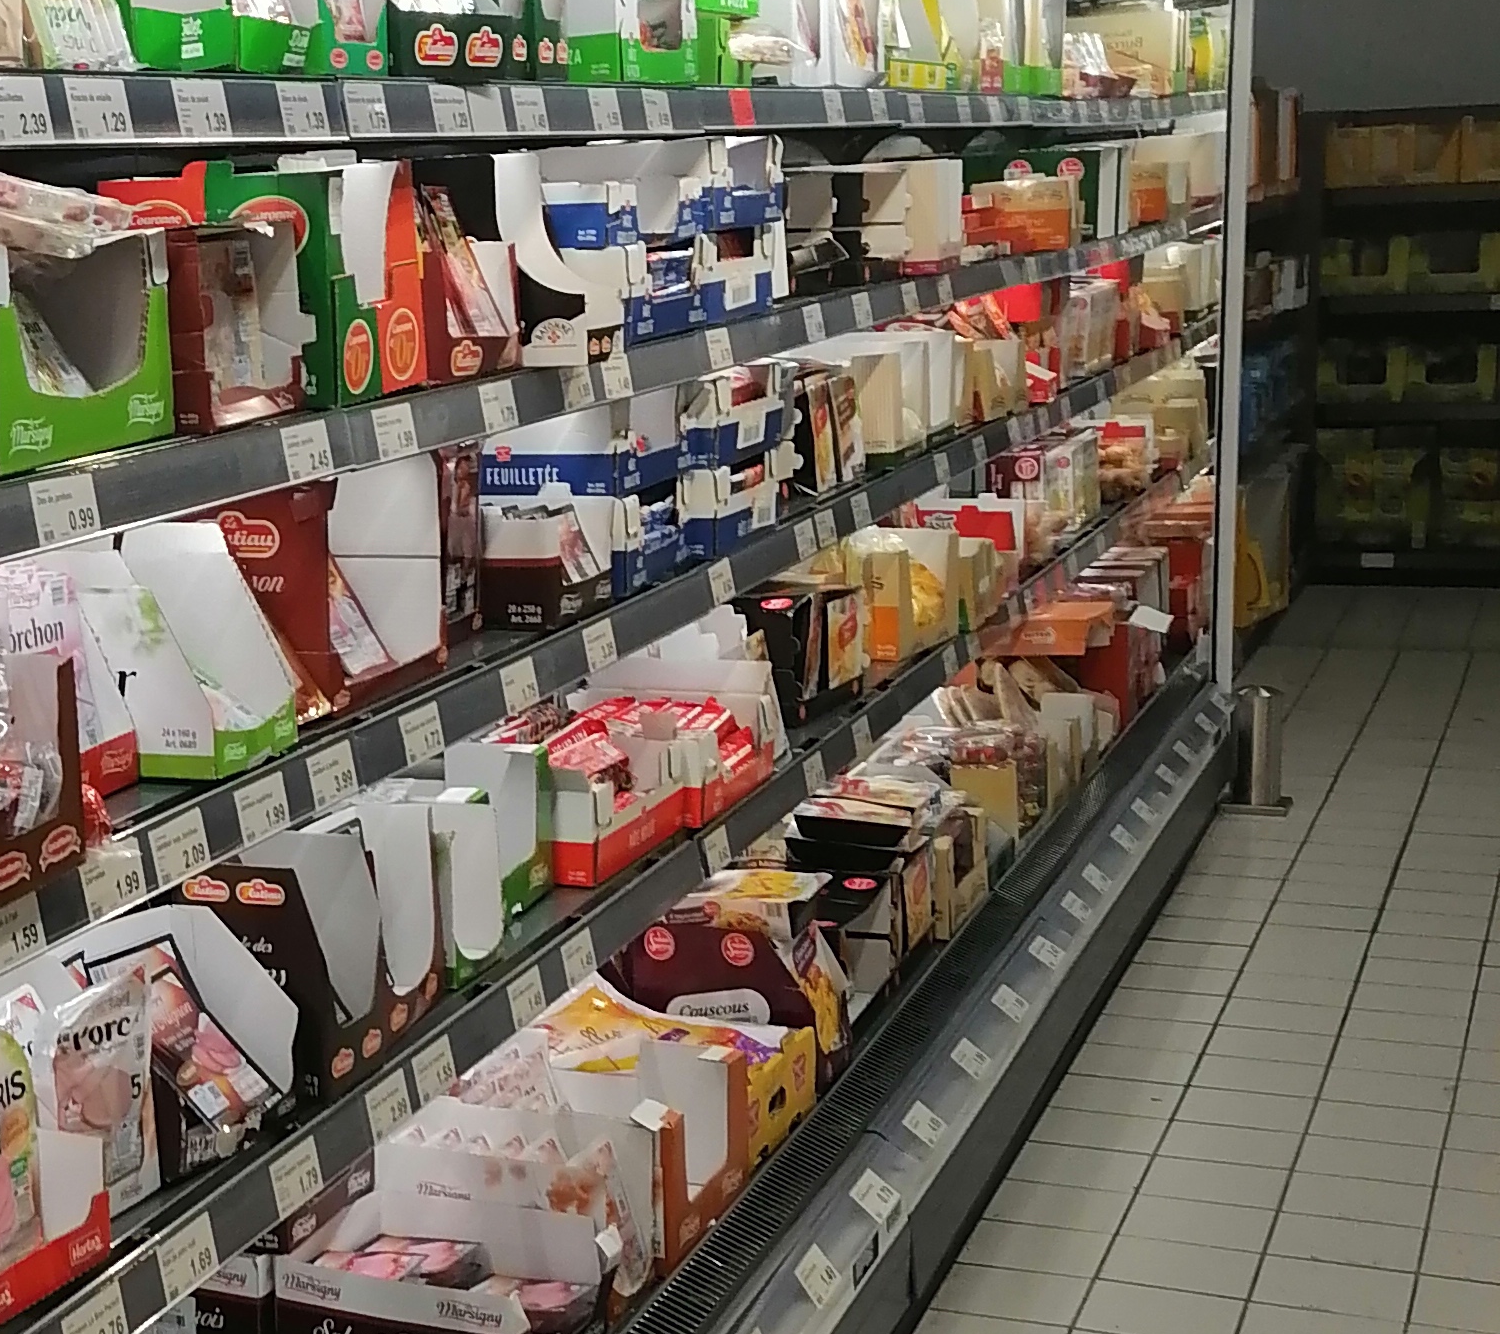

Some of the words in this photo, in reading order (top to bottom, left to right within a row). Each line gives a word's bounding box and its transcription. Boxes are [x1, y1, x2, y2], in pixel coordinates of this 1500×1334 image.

[19, 113, 48, 136] 2.39
[101, 111, 127, 133] 1.29
[205, 111, 227, 133] 1.39
[305, 111, 325, 131] 1.39
[130, 214, 183, 226] Couronne
[534, 318, 575, 343] BAYONNE
[308, 448, 332, 472] 2.45
[68, 507, 96, 532] 0.99
[334, 768, 354, 795] 3.99
[264, 803, 287, 829] 1.99
[182, 841, 208, 868] 2.09
[115, 870, 142, 900] 1.99
[10, 922, 39, 954] 1.59
[678, 999, 750, 1017] Couscous
[299, 1168, 320, 1196] 1.79
[189, 1246, 213, 1278] 1.69
[281, 1272, 342, 1302] Marsigny
[436, 1300, 503, 1328] Marsigny
